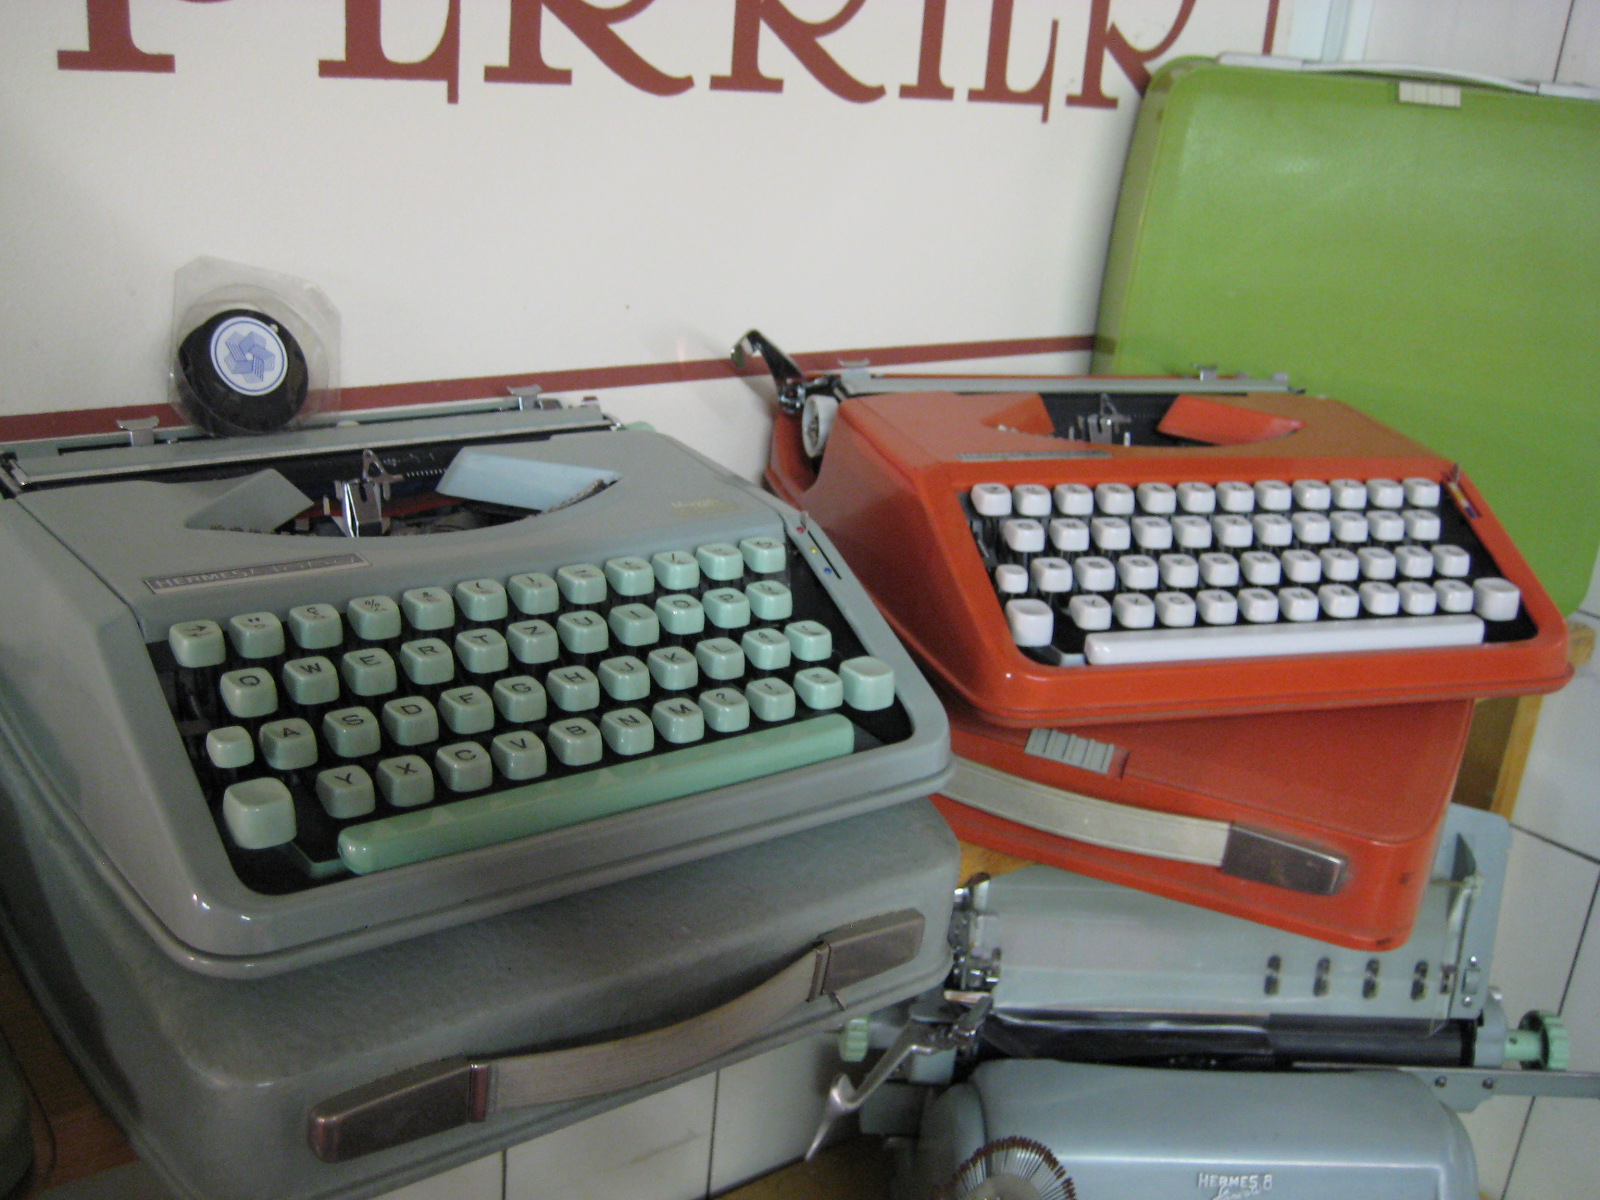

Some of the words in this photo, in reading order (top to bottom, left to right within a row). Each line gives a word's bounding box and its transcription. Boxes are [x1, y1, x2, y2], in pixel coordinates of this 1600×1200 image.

[298, 661, 324, 675] W
[359, 653, 382, 667] E
[417, 644, 441, 656] R
[471, 633, 489, 645] T
[523, 624, 544, 636] Z
[572, 615, 594, 627] U
[282, 726, 302, 738] A
[341, 713, 365, 726] S
[400, 703, 423, 715] D
[459, 691, 475, 705] F
[511, 681, 533, 694] G
[563, 670, 587, 683] H
[333, 771, 354, 785] Y
[394, 761, 419, 775] X
[454, 748, 478, 761] C
[508, 736, 527, 749] V
[565, 724, 588, 736] B
[616, 713, 641, 727] N
[667, 702, 694, 716] M
[1198, 1172, 1260, 1189] HERMES
[1263, 1174, 1273, 1192] 8
